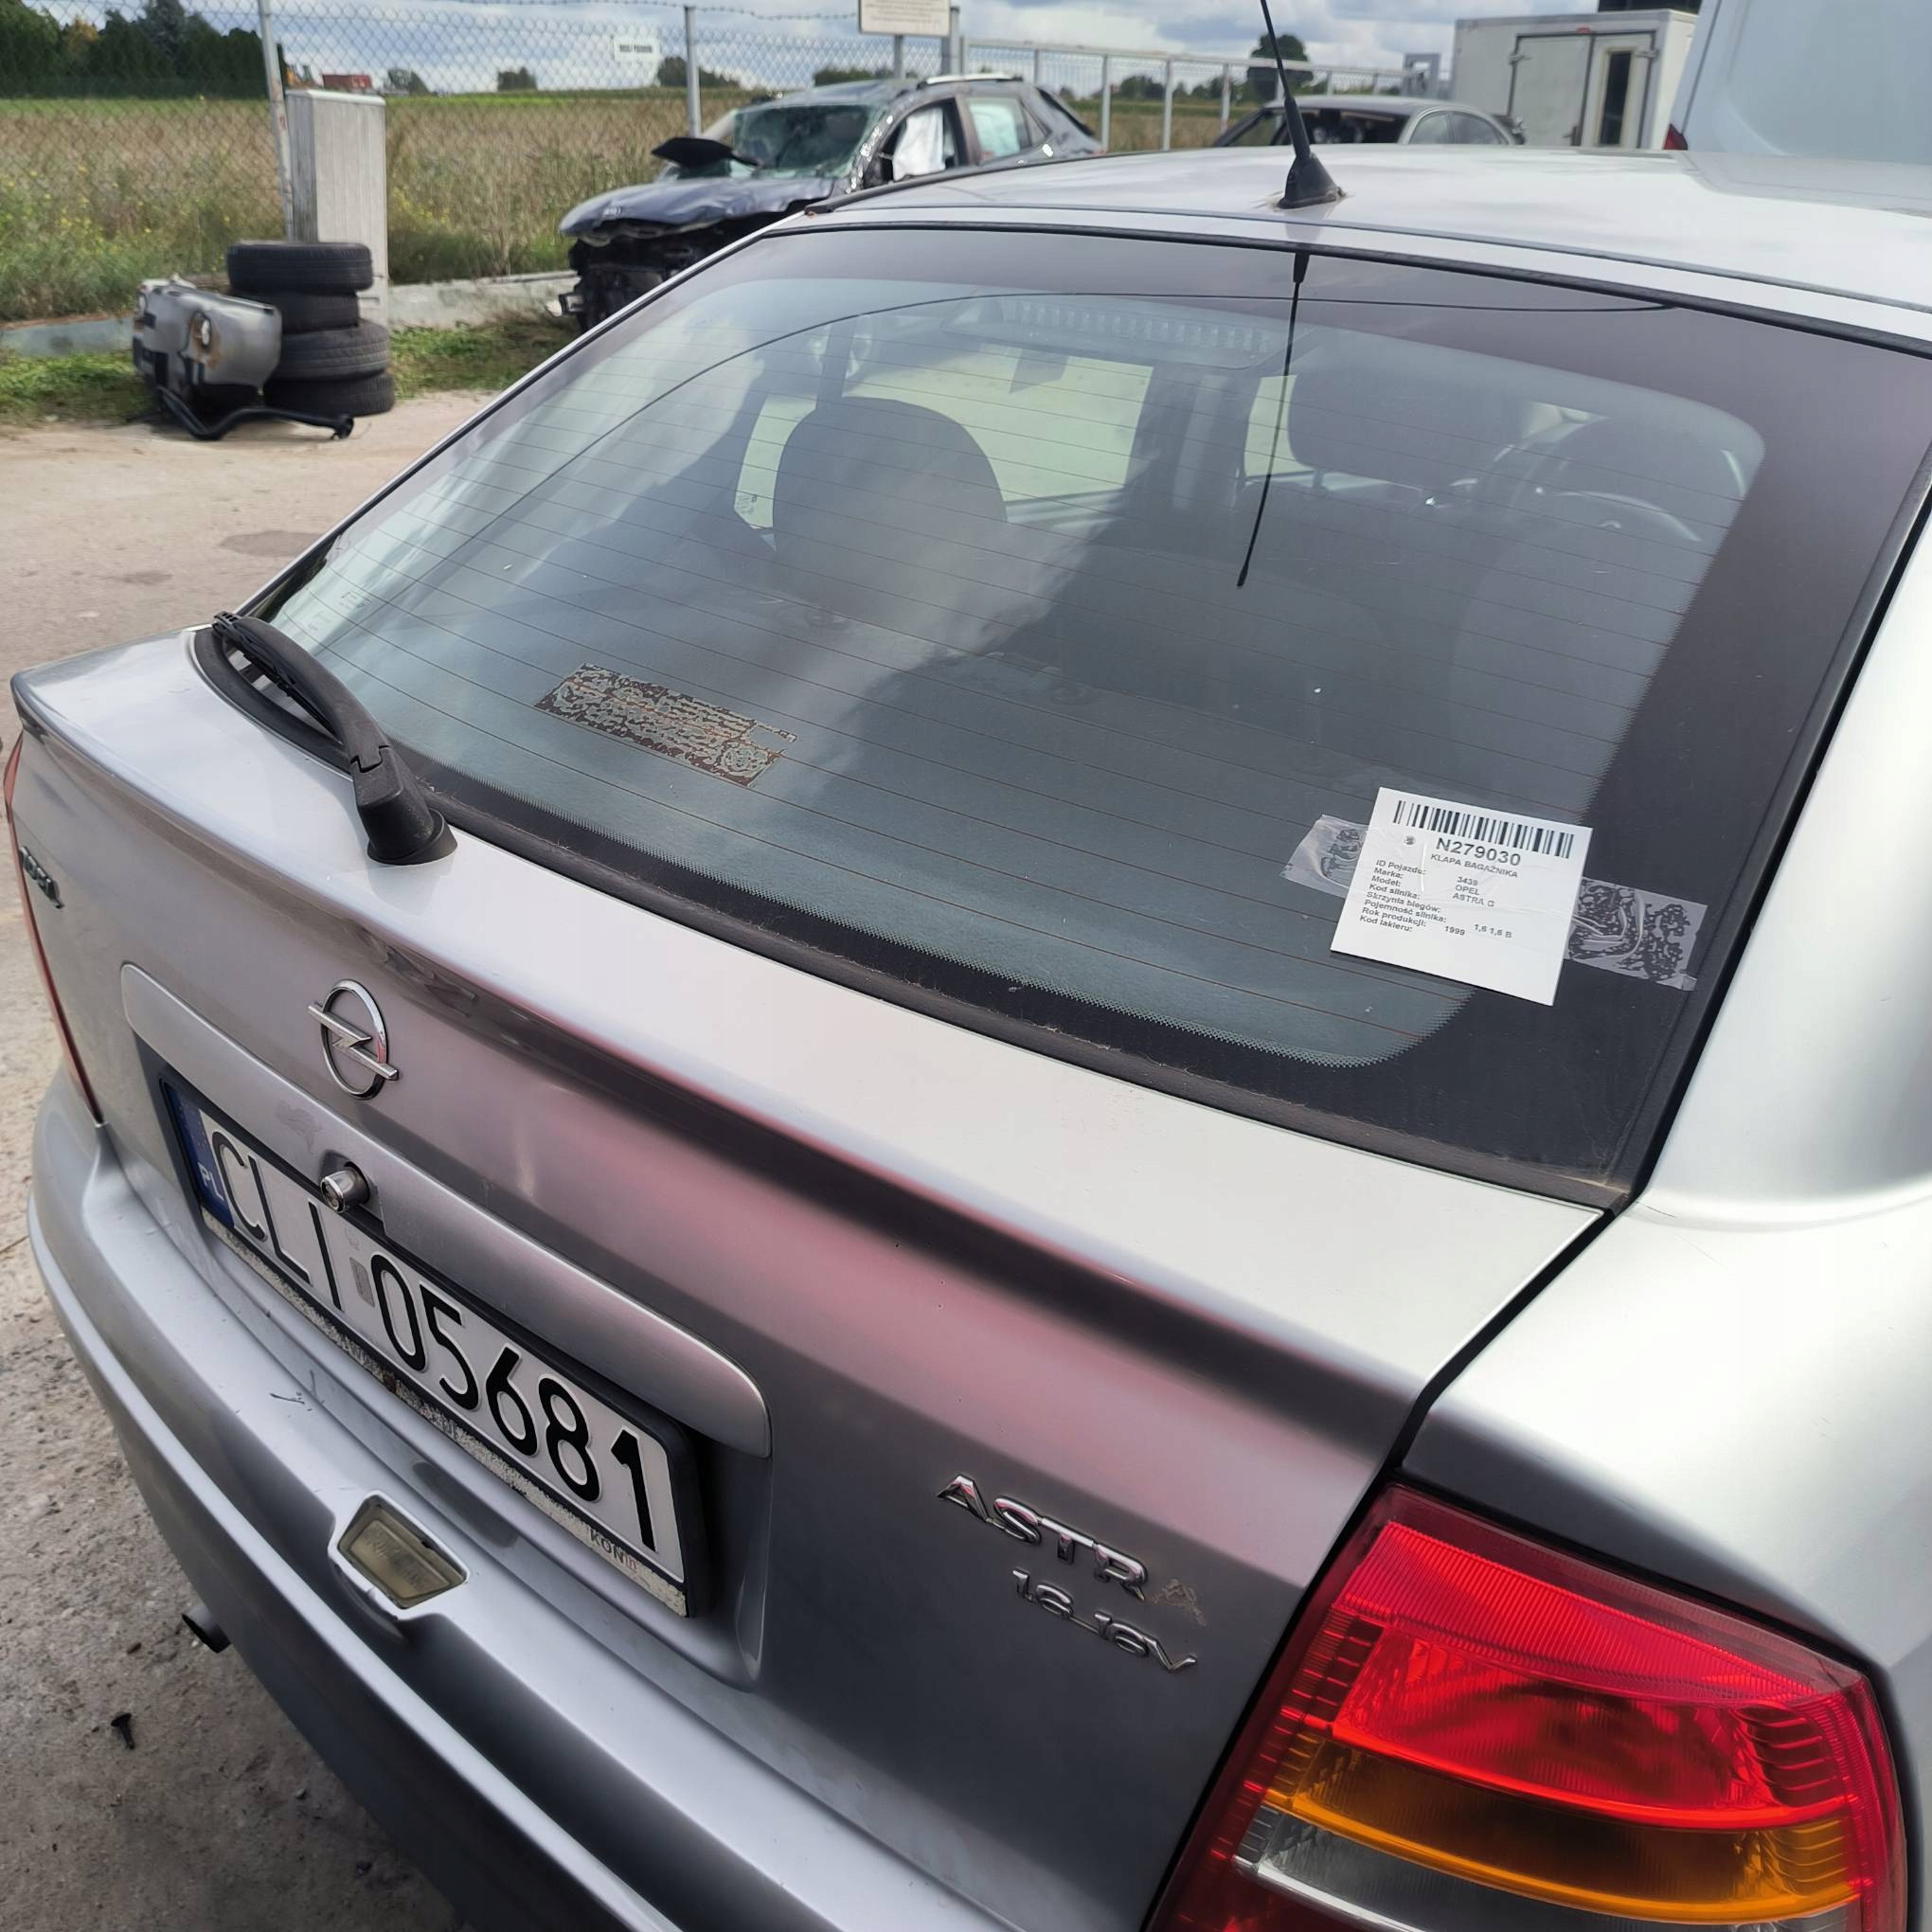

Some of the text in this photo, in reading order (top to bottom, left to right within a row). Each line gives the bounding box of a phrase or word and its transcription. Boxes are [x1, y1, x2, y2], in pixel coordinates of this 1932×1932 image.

[1430, 853, 1461, 866] KLAPA
[1436, 837, 1521, 867] N279030
[1373, 868, 1404, 879] Marka:
[1387, 862, 1426, 875] Pojazdu:
[1371, 875, 1401, 886] Model:
[1368, 884, 1421, 900] Kod silnika:
[1452, 892, 1485, 905] ASTRA
[1455, 885, 1480, 896] OPEL
[1366, 891, 1441, 913] Skrzynia biegów:
[1362, 906, 1427, 927] Rok produkcji:
[1364, 899, 1447, 922] Pojemność silnika:
[1359, 915, 1413, 932] Kod lakieru:
[1444, 925, 1466, 936] 1999
[198, 1161, 224, 1201] PL
[370, 1254, 657, 1553] 05681
